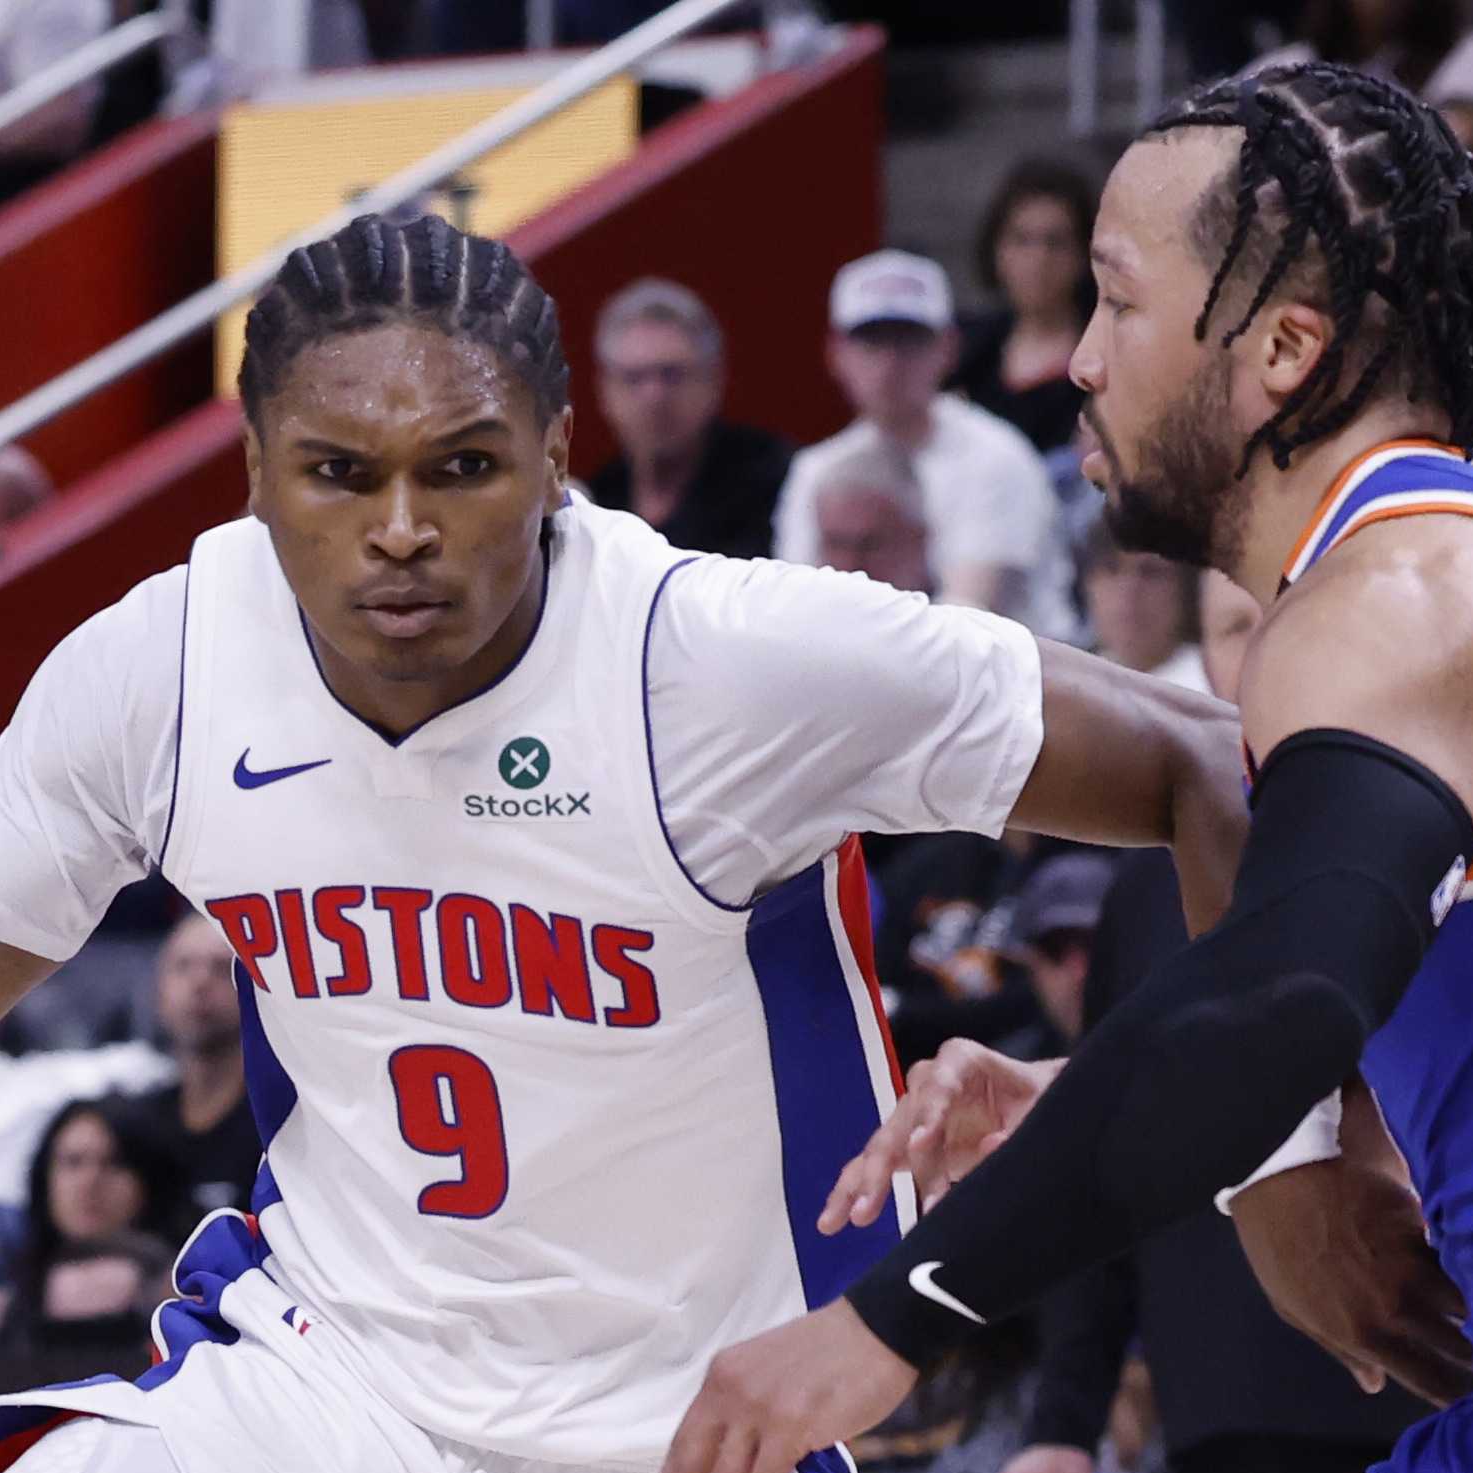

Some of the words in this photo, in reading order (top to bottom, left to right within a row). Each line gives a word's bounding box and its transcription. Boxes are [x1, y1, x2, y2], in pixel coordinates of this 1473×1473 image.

[463, 791, 591, 818] StockX
[204, 884, 662, 1029] PISTONS
[388, 1043, 510, 1221] 9
